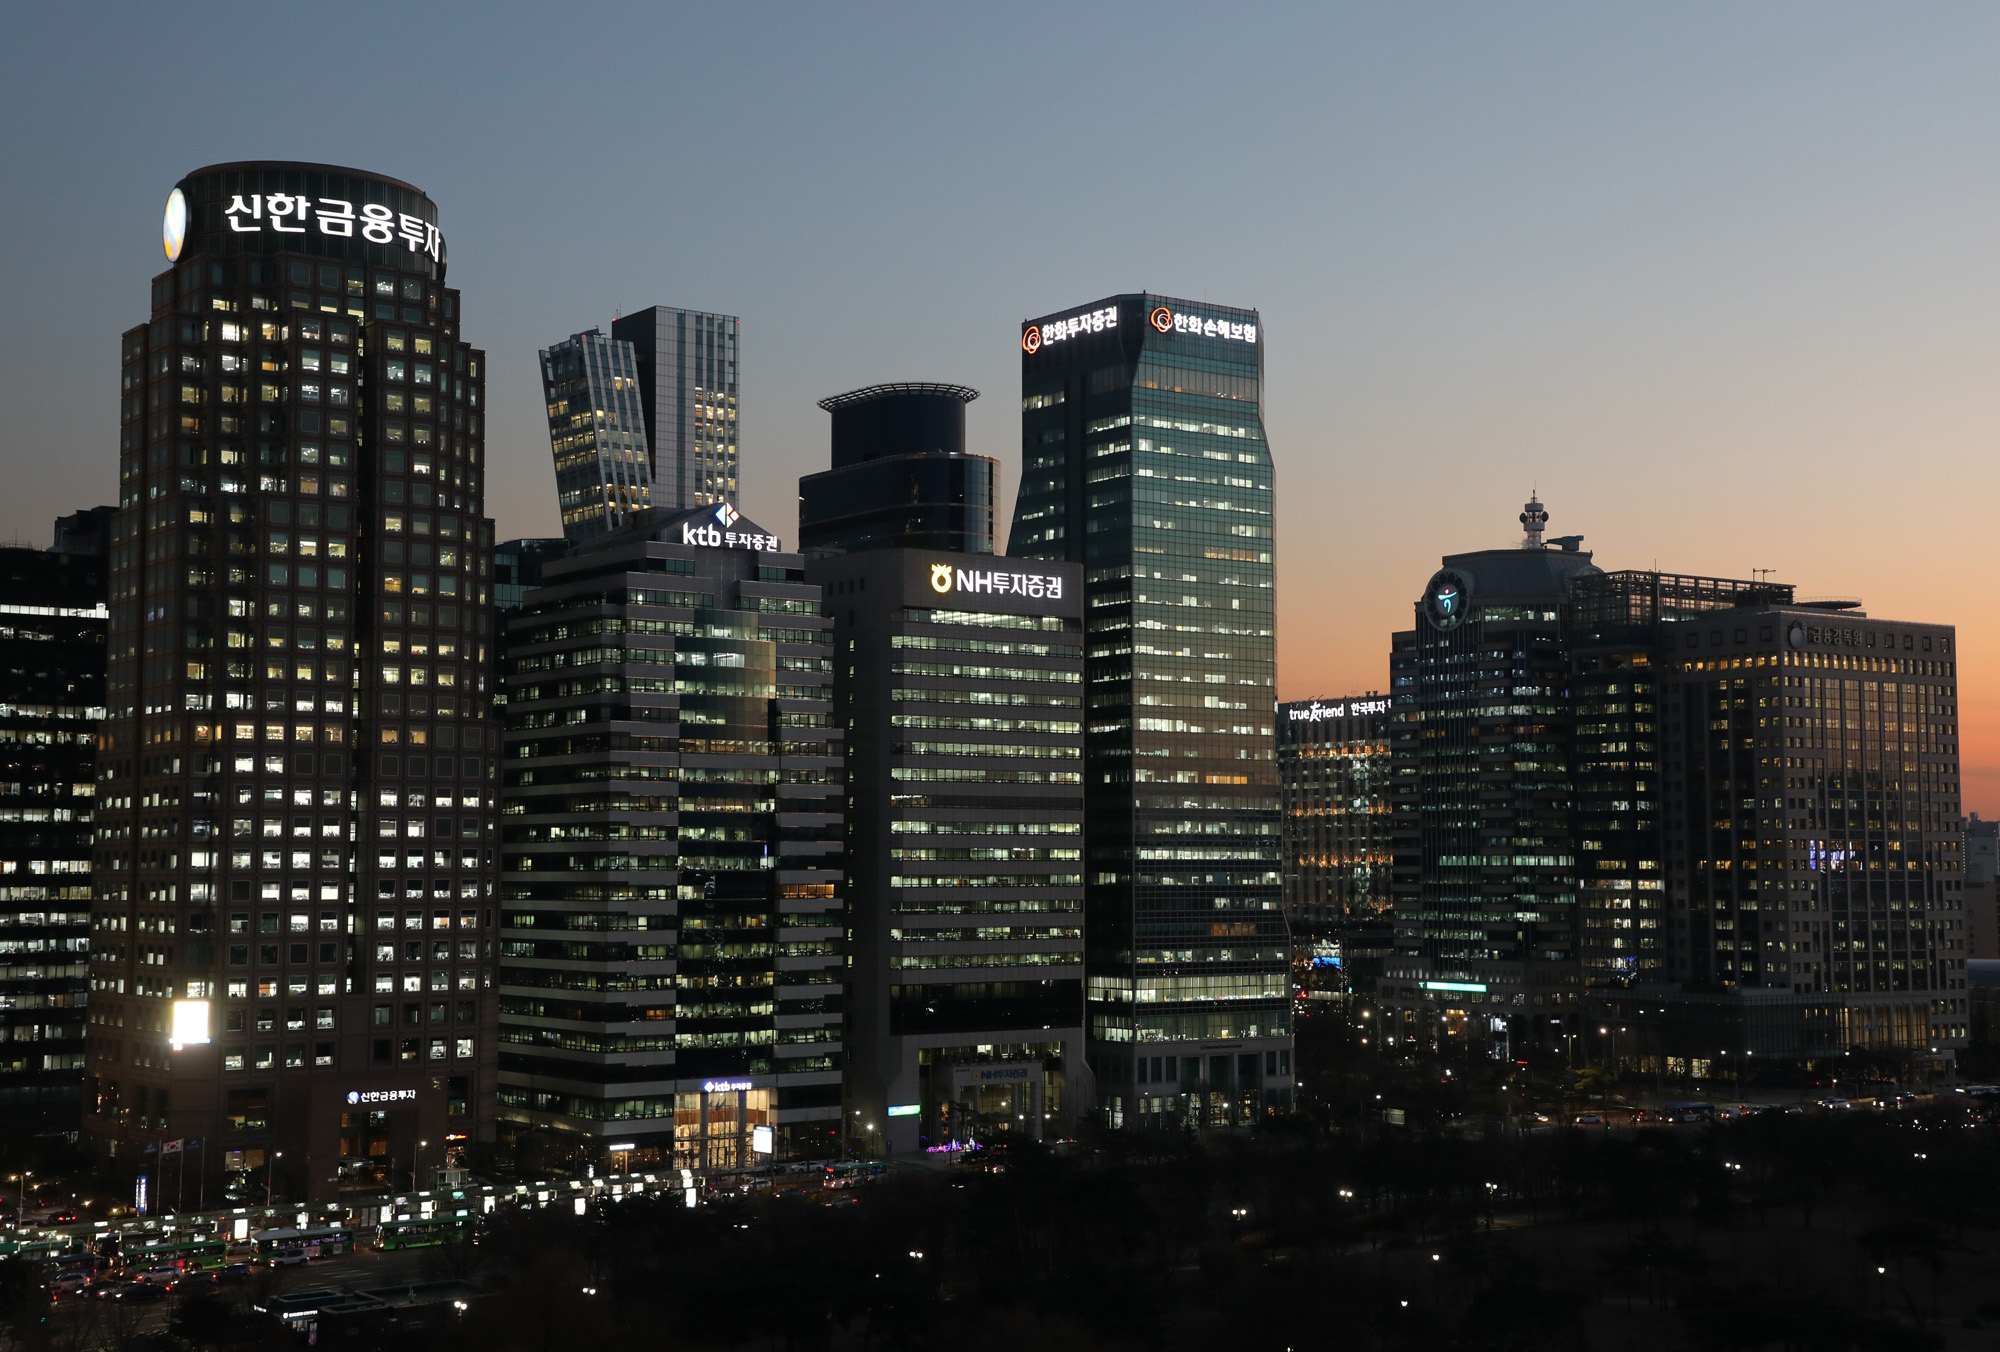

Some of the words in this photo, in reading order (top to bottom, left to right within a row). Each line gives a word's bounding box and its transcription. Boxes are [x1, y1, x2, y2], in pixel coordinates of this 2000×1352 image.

[224, 192, 441, 263] 신한금융투자
[1042, 306, 1118, 346] 한화투자증권
[1173, 313, 1257, 343] 한화손해보험
[682, 521, 721, 547] ktb
[724, 532, 778, 552] 투자증권
[956, 569, 1062, 599] NH투자증권
[1812, 626, 1863, 647] 금융감독원
[360, 1089, 417, 1103] 신한금융투자
